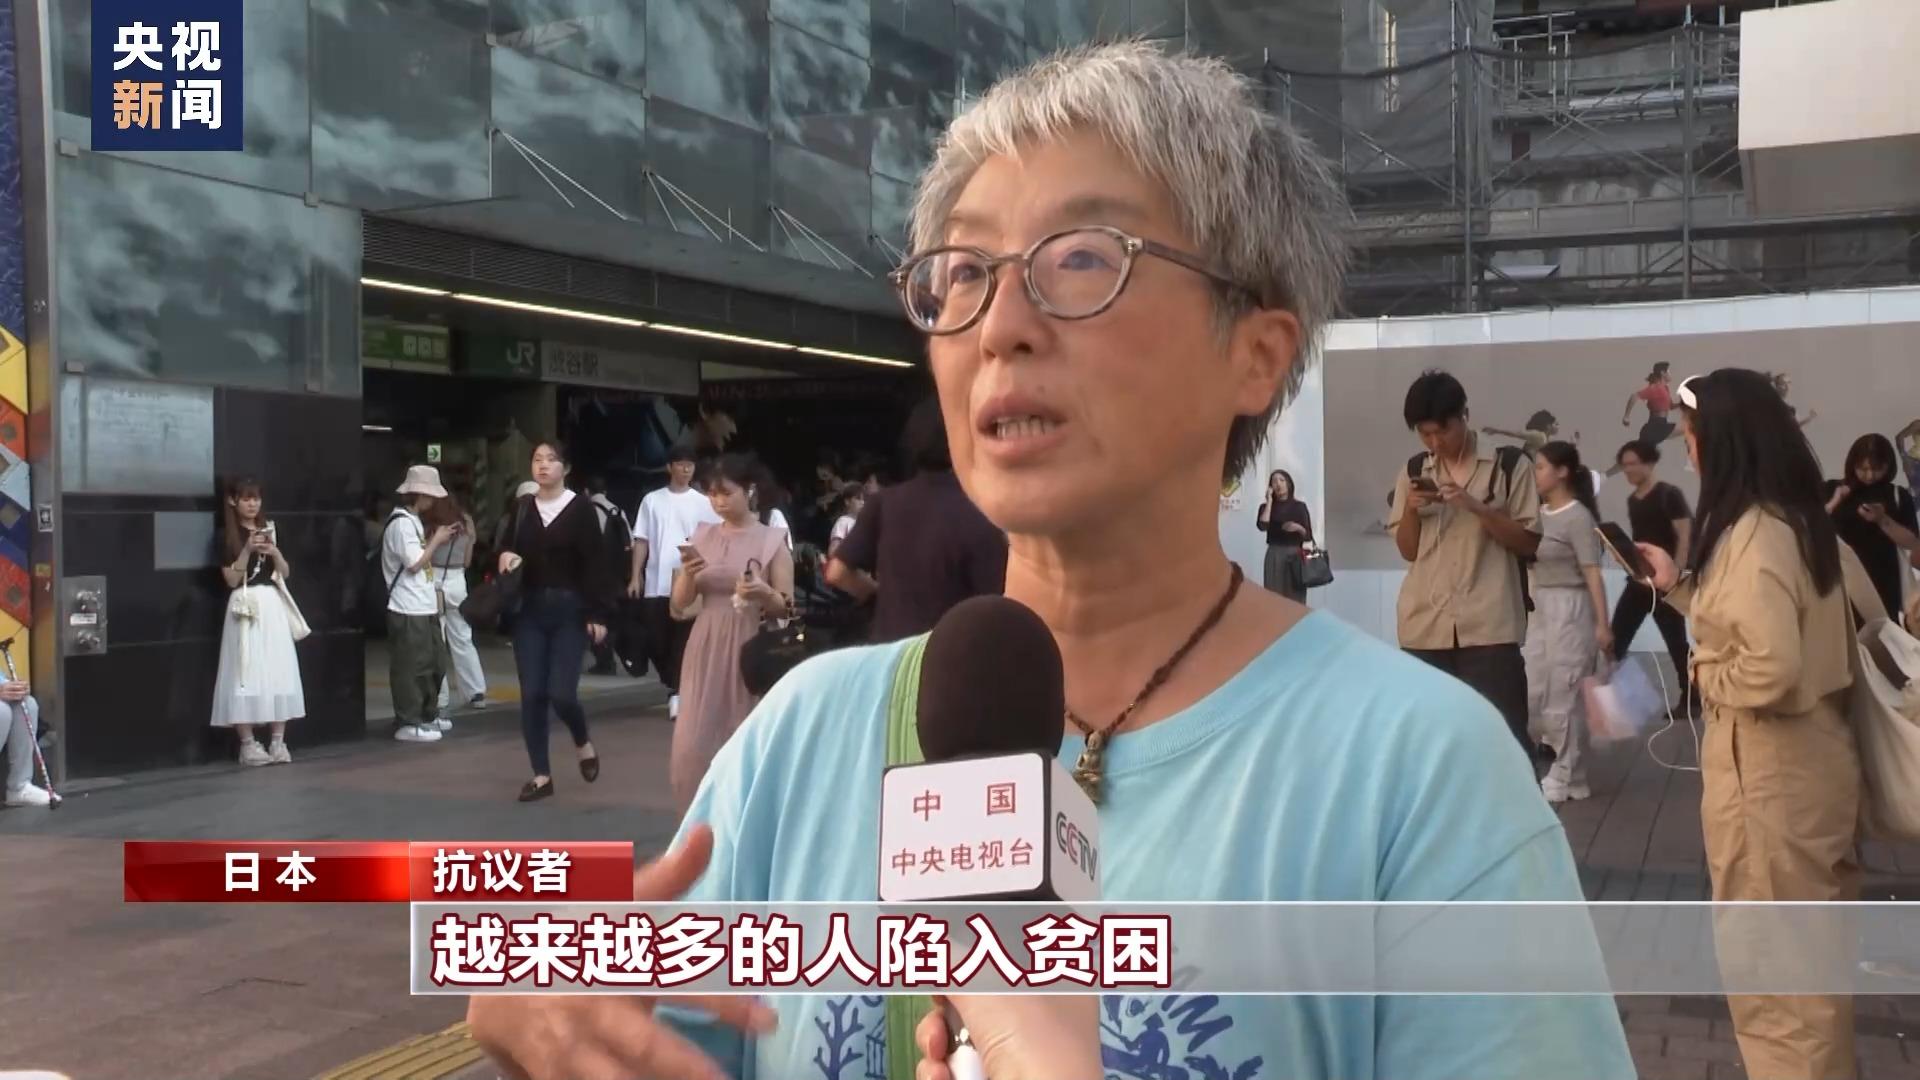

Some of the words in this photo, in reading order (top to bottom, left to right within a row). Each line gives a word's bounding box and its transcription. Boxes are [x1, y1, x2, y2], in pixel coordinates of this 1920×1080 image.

[506, 341, 534, 367] JR
[891, 837, 1034, 877] 中央电视台
[1055, 811, 1098, 882] CCTV
